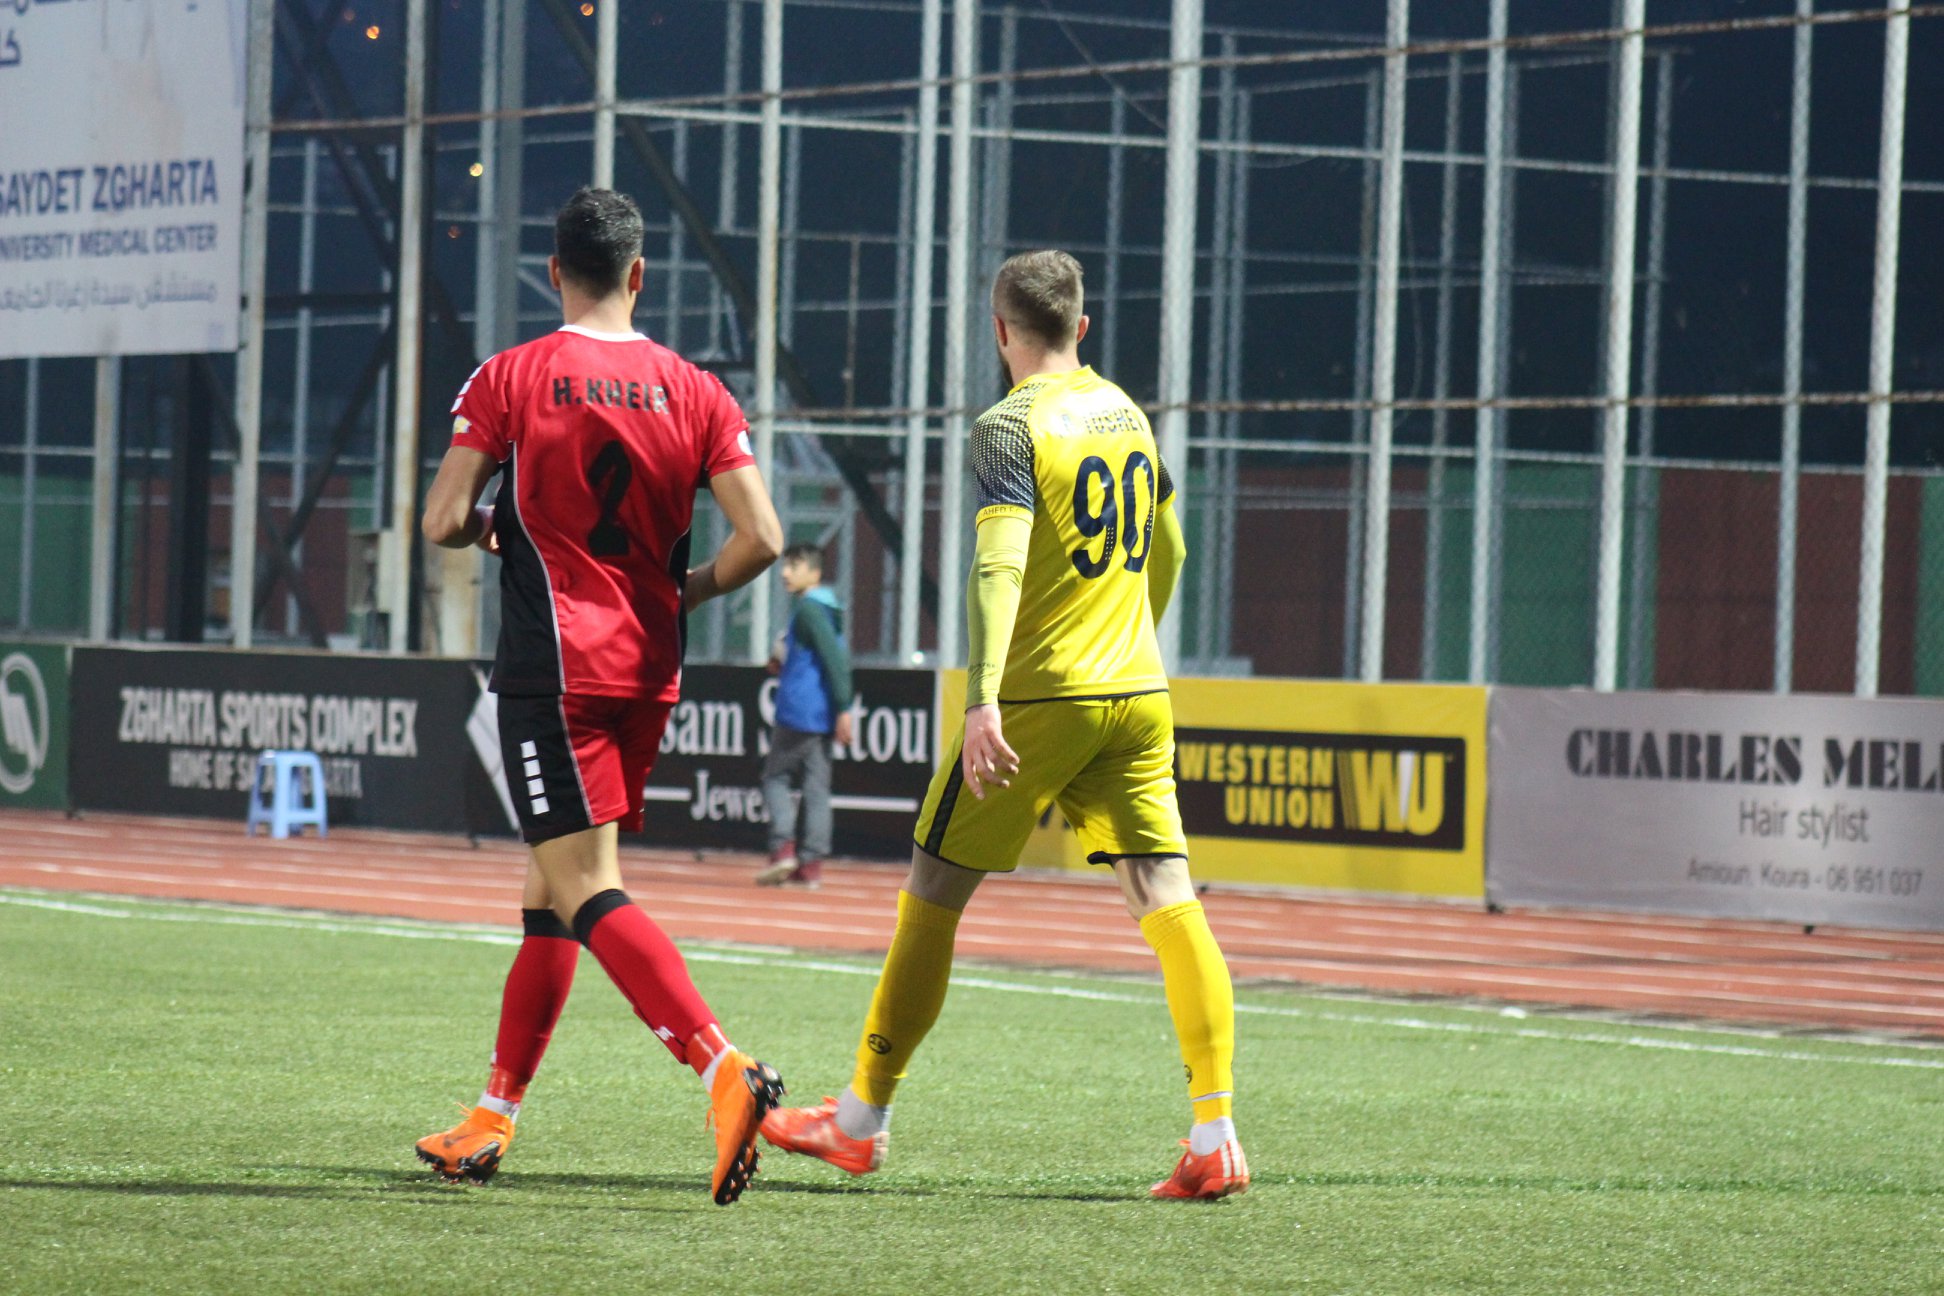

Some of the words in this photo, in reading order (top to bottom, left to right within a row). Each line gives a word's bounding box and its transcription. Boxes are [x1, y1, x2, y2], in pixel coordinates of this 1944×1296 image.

[92, 158, 218, 212] ZGHARTA
[79, 228, 149, 258] MEDICAL
[153, 222, 217, 254] CENTER
[587, 440, 633, 557] 2
[1072, 450, 1155, 580] 90
[119, 685, 217, 746] ZGHARTA
[220, 689, 308, 751] SPORTS
[311, 694, 418, 758] COMPLEX
[168, 750, 212, 790] HOME
[214, 751, 234, 791] OF
[1177, 742, 1334, 787] WESTERN
[1566, 728, 1803, 786] CHARLES
[1823, 736, 1944, 793] MEL
[1224, 785, 1334, 829] UNION
[1338, 750, 1445, 836] WU
[1738, 800, 1789, 838] Hair
[1797, 803, 1871, 849] stylist
[1760, 859, 1810, 890] Koura
[1827, 863, 1849, 892] 06
